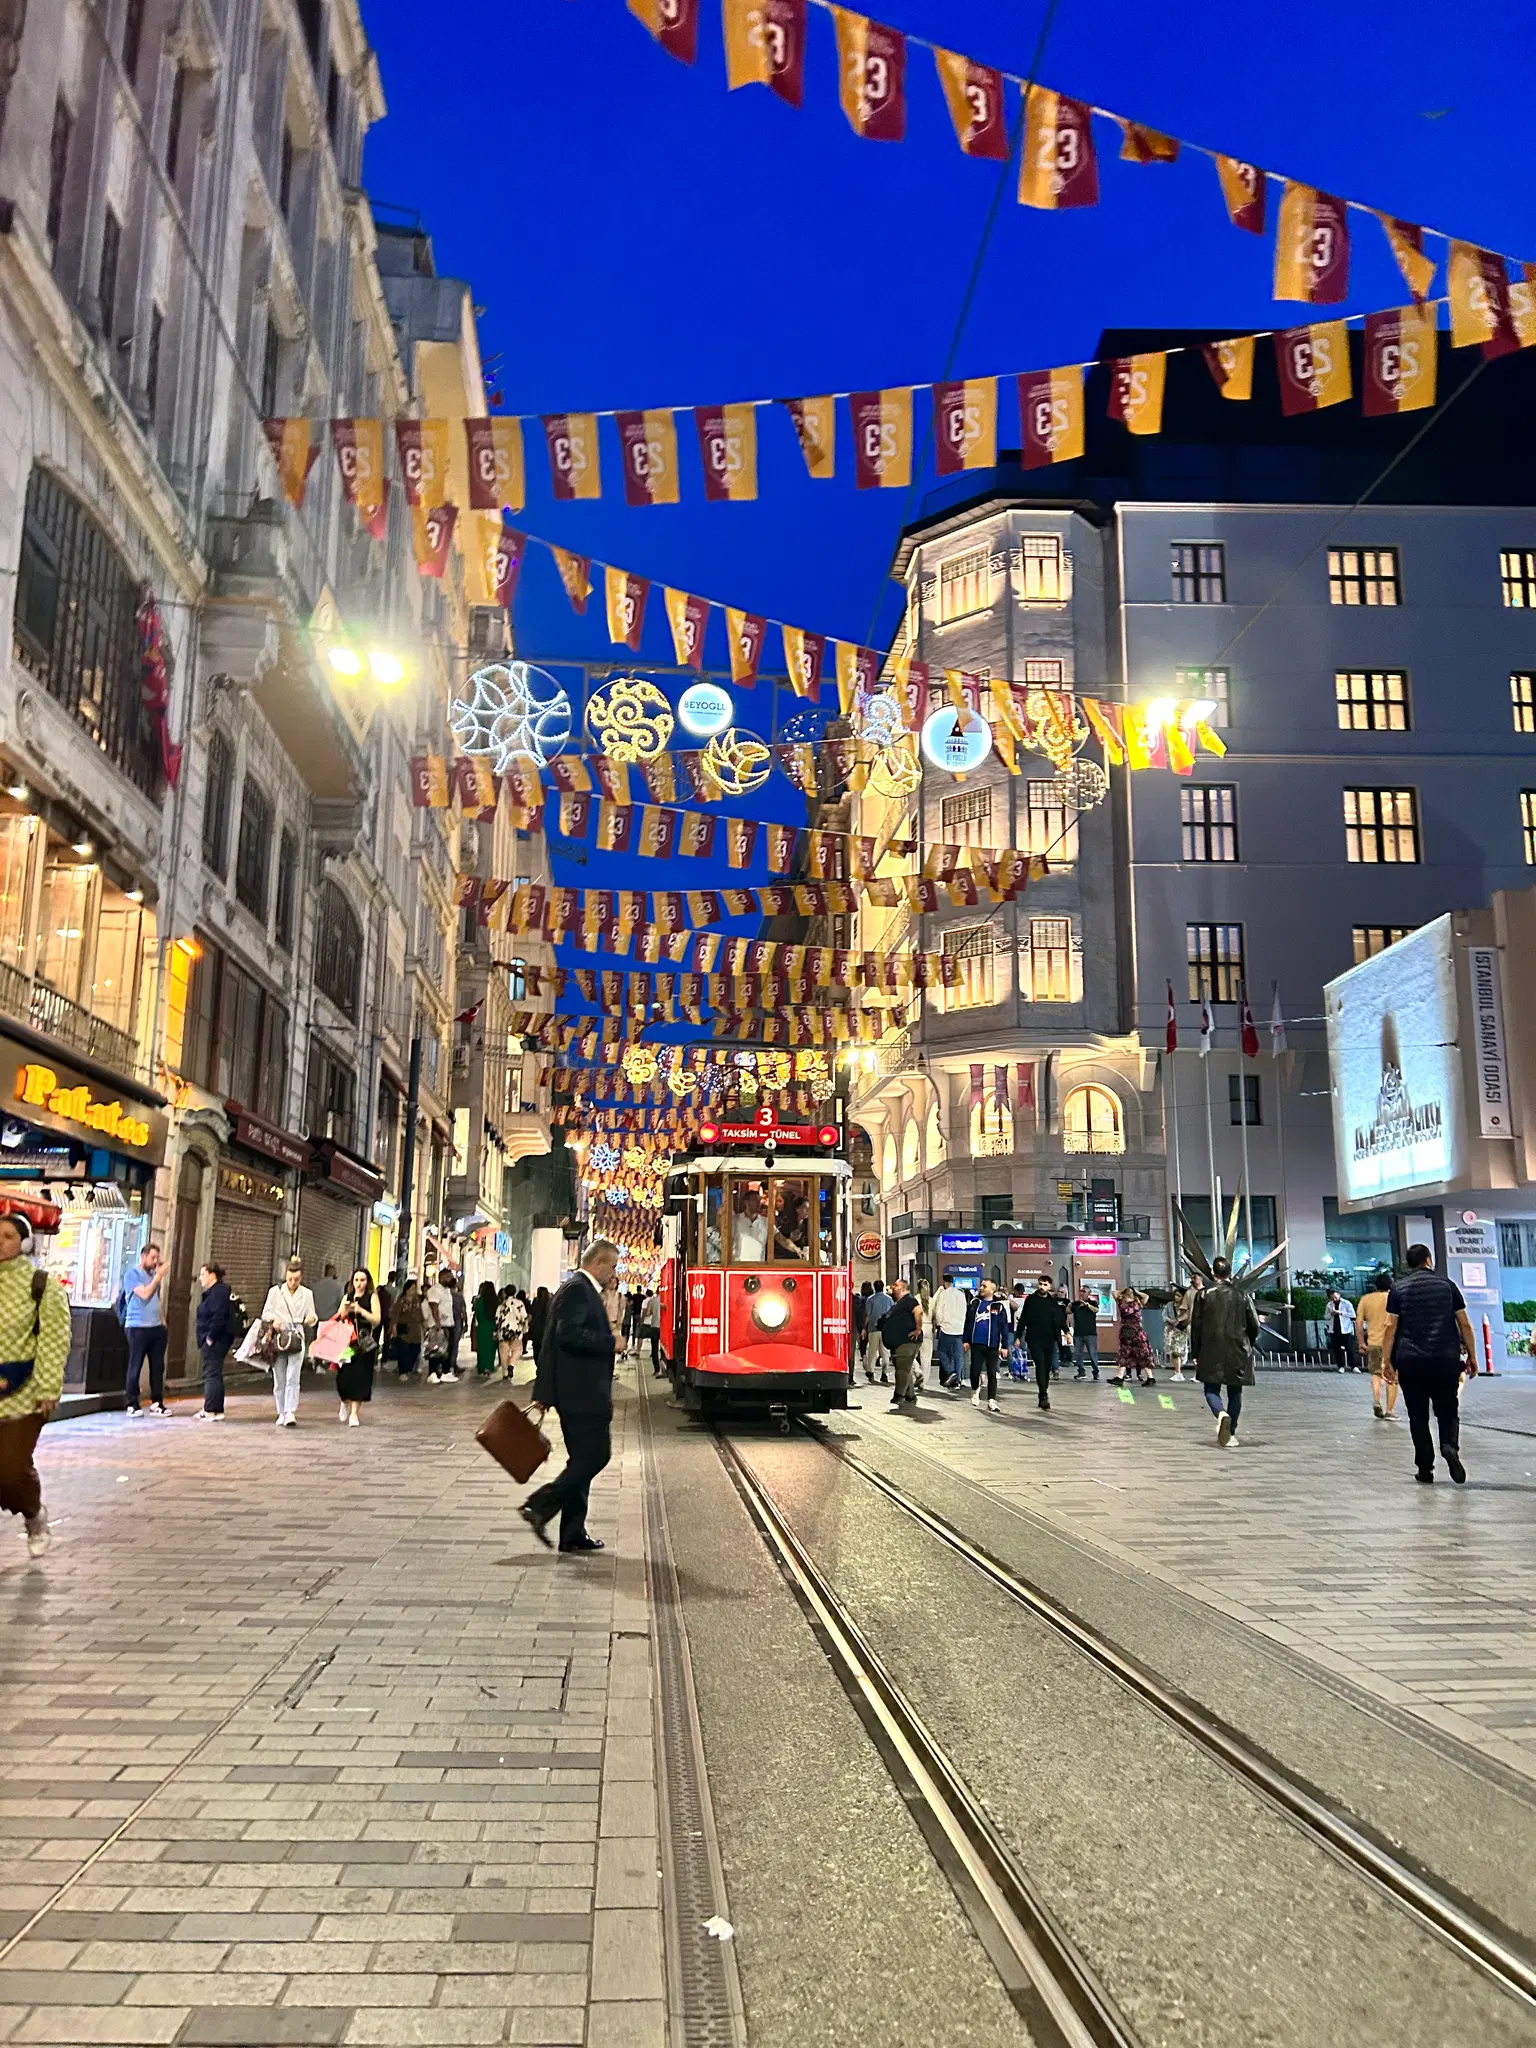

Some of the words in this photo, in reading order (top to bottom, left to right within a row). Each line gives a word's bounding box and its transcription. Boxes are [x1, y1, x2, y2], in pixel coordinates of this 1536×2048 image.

[1037, 128, 1078, 169] 23
[1475, 951, 1493, 1012] İSTANBUL
[1480, 1015, 1501, 1060] SANAYİ
[1484, 1064, 1501, 1103] ODASI
[22, 1064, 150, 1146] Patates
[760, 1107, 773, 1126] 3
[722, 1128, 757, 1138] TAKSİM
[770, 1129, 801, 1139] TÜNEL
[860, 1243, 881, 1251] KING
[1458, 1237, 1484, 1245] TİCARET
[692, 1284, 705, 1300] 410
